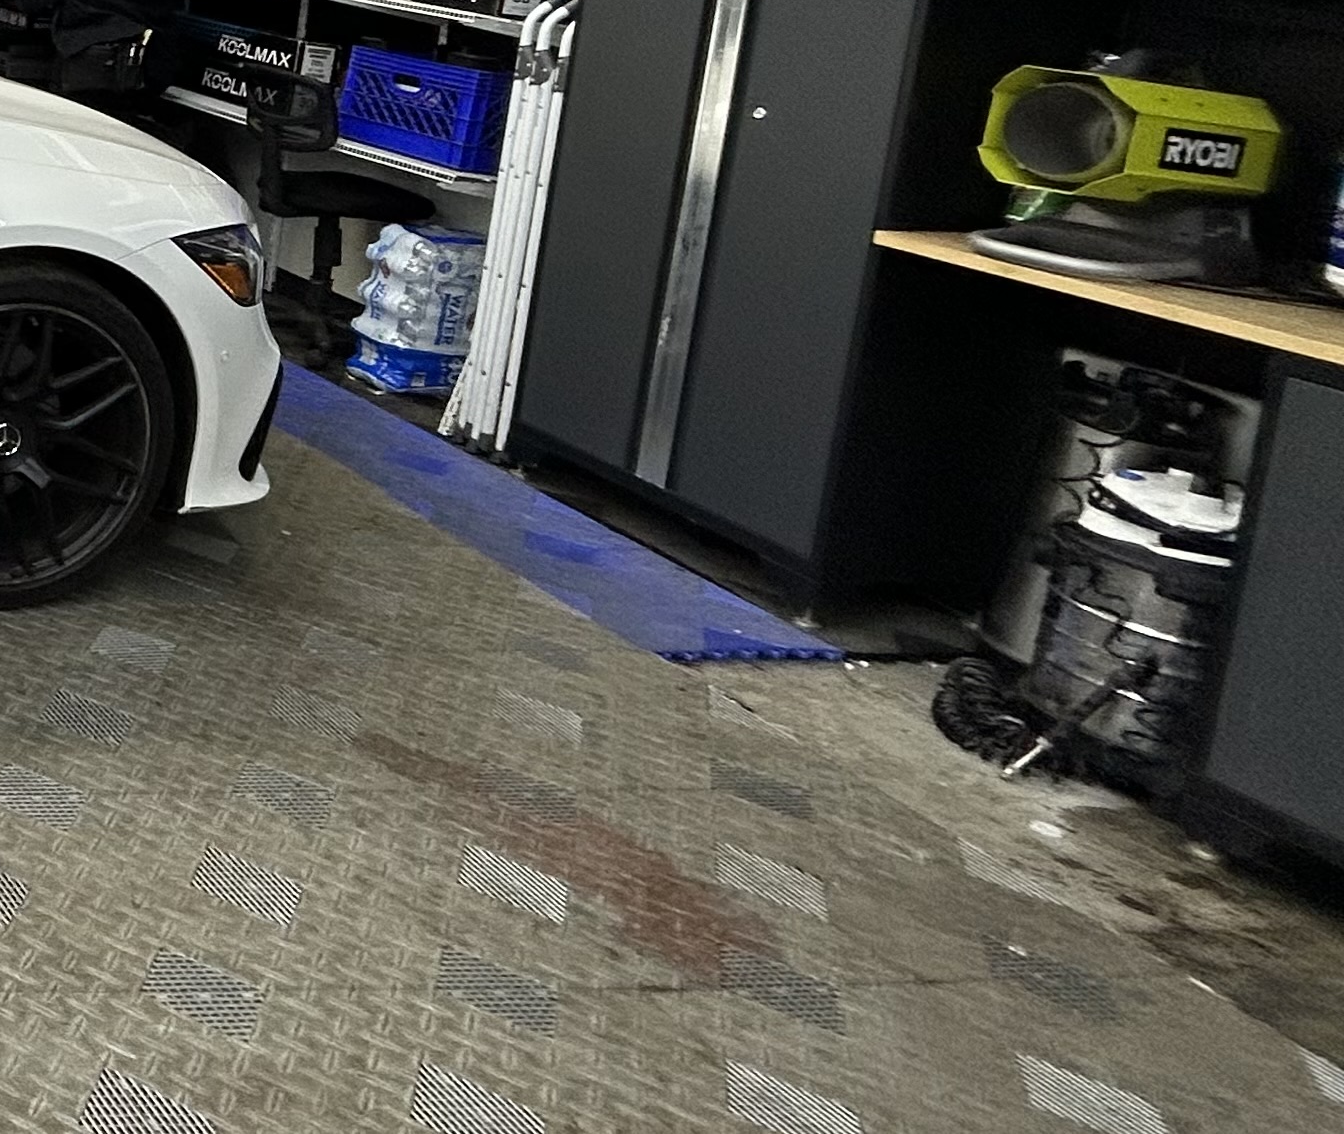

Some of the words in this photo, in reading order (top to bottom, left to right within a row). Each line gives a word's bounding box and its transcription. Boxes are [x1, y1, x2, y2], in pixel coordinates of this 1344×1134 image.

[217, 36, 292, 69] KOOLMAX
[1163, 135, 1240, 171] RYOBI
[443, 294, 463, 346] WATER
